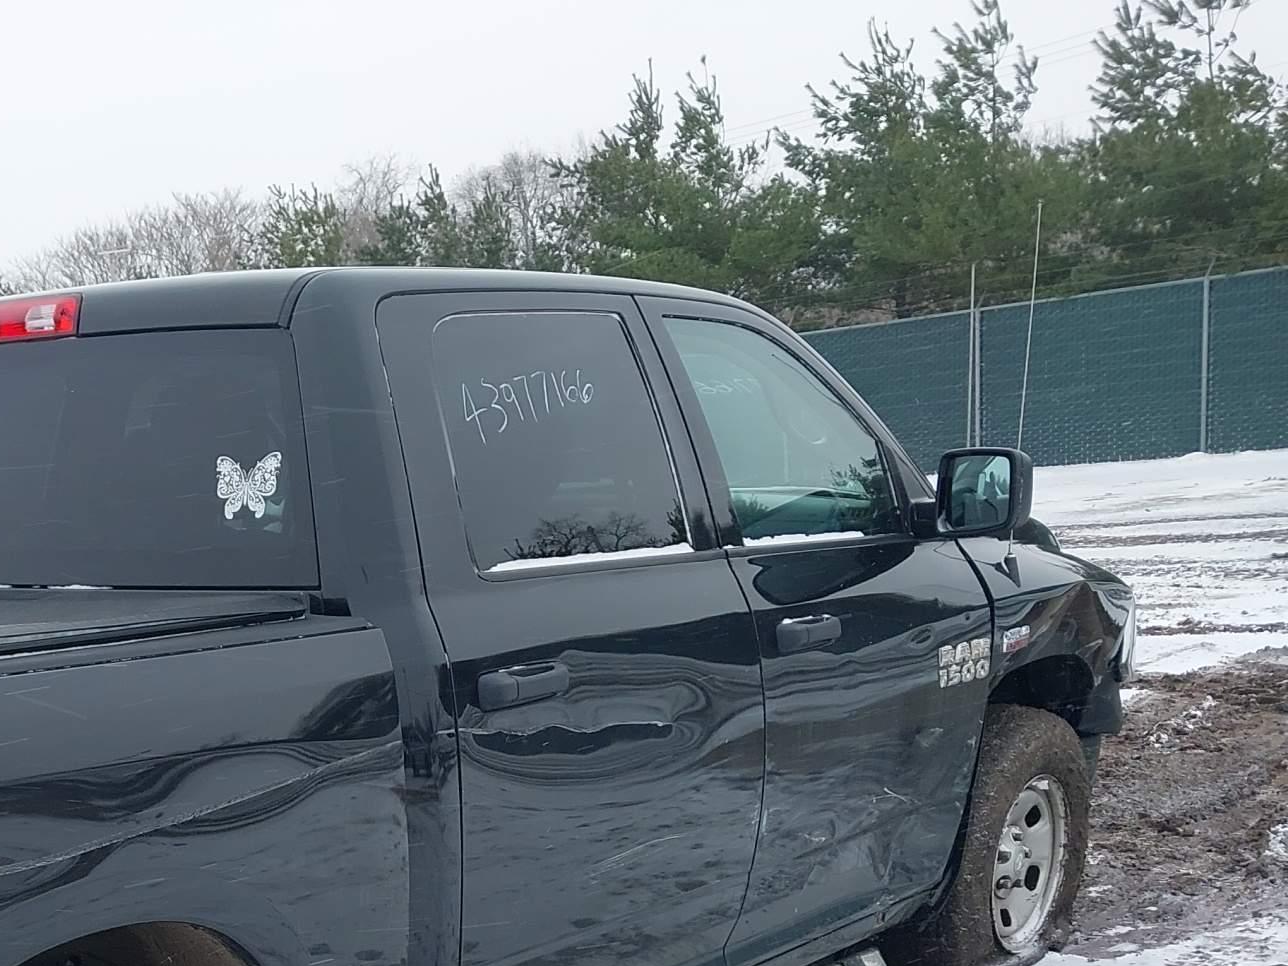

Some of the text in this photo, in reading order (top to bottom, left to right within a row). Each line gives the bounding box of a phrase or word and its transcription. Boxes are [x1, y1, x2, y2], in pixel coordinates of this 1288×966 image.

[461, 369, 594, 445] 43977166
[938, 637, 992, 667] RAM
[938, 659, 990, 689] 1500
